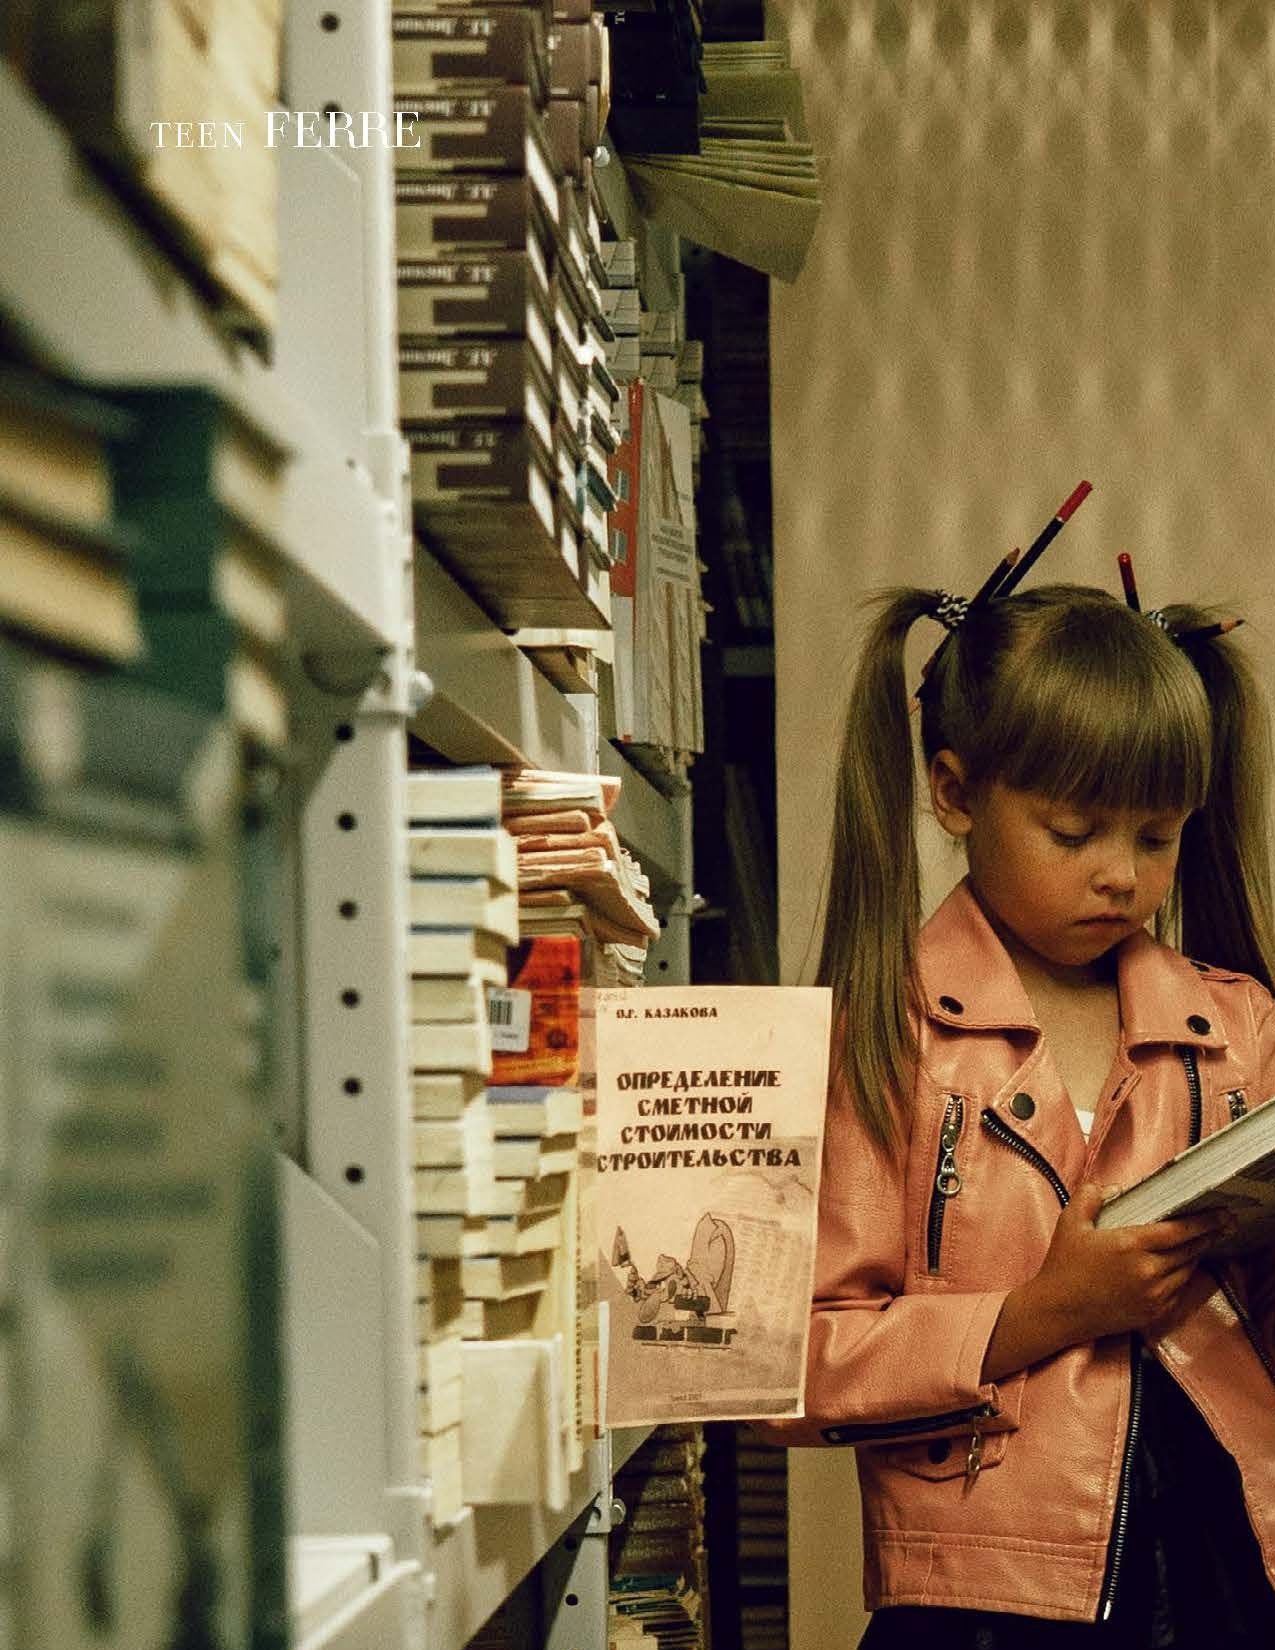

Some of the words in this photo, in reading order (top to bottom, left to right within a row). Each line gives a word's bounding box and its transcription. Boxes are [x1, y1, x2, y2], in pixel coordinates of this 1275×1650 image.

[644, 1006, 719, 1020] КАЗАКОВА
[617, 1070, 783, 1093] ОПРЕДЕЛЕНИЕ
[637, 1092, 754, 1117] СМЕТНОЙ
[620, 1122, 773, 1144] СТОИМОСТИ
[597, 1148, 801, 1173] СТРОИТЕЛЬСТВА
